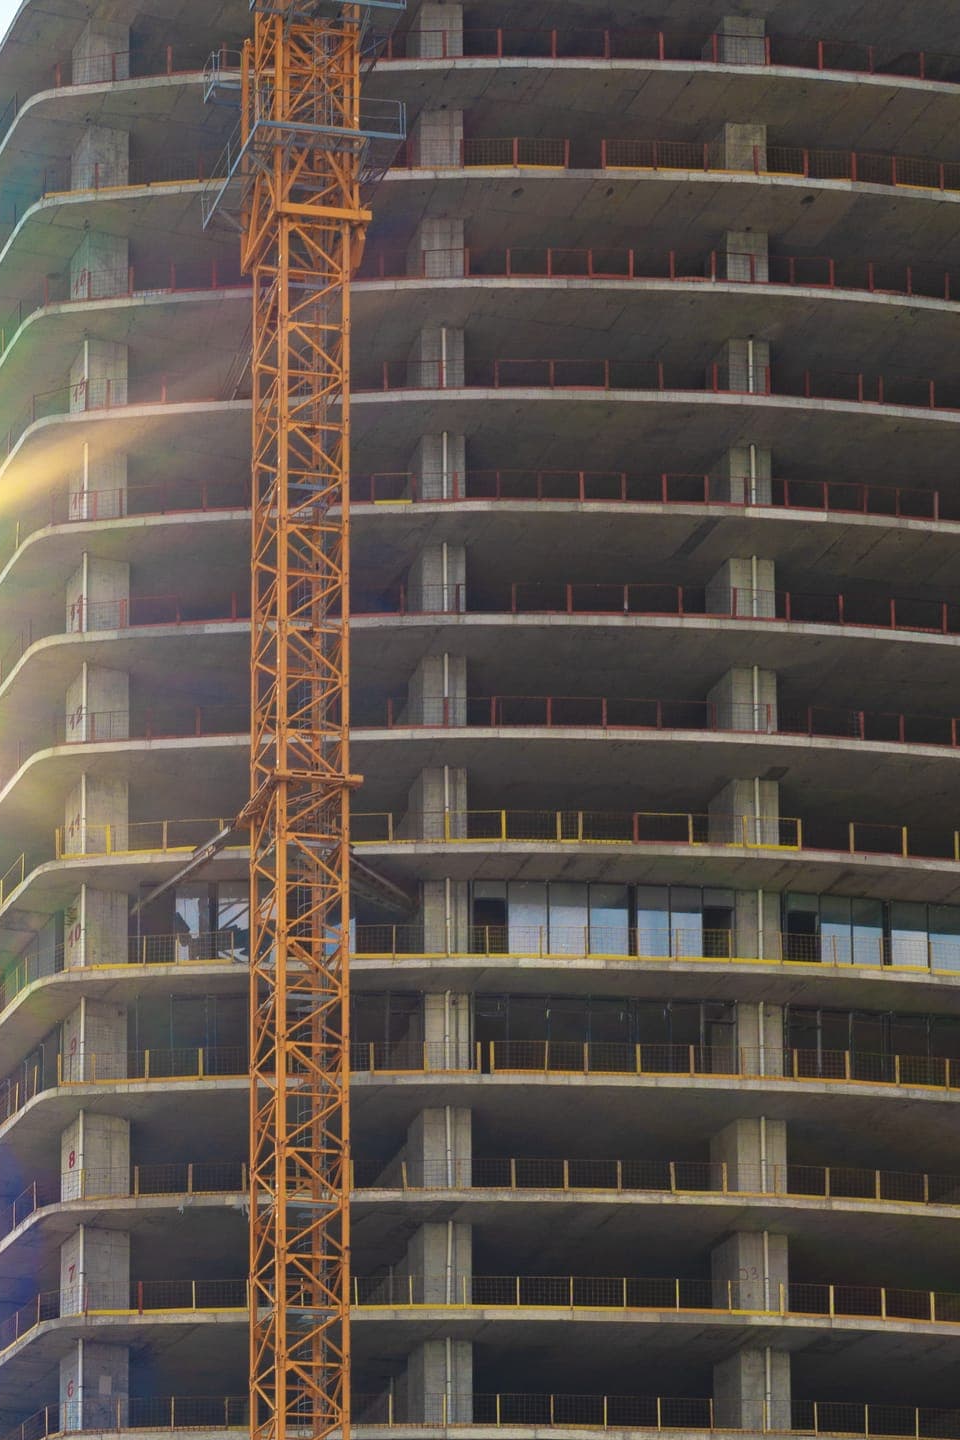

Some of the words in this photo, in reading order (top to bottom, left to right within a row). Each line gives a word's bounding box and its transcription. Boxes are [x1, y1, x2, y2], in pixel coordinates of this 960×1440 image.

[68, 1150, 76, 1169] 8
[68, 1263, 76, 1283] 7
[67, 1379, 74, 1398] 6
